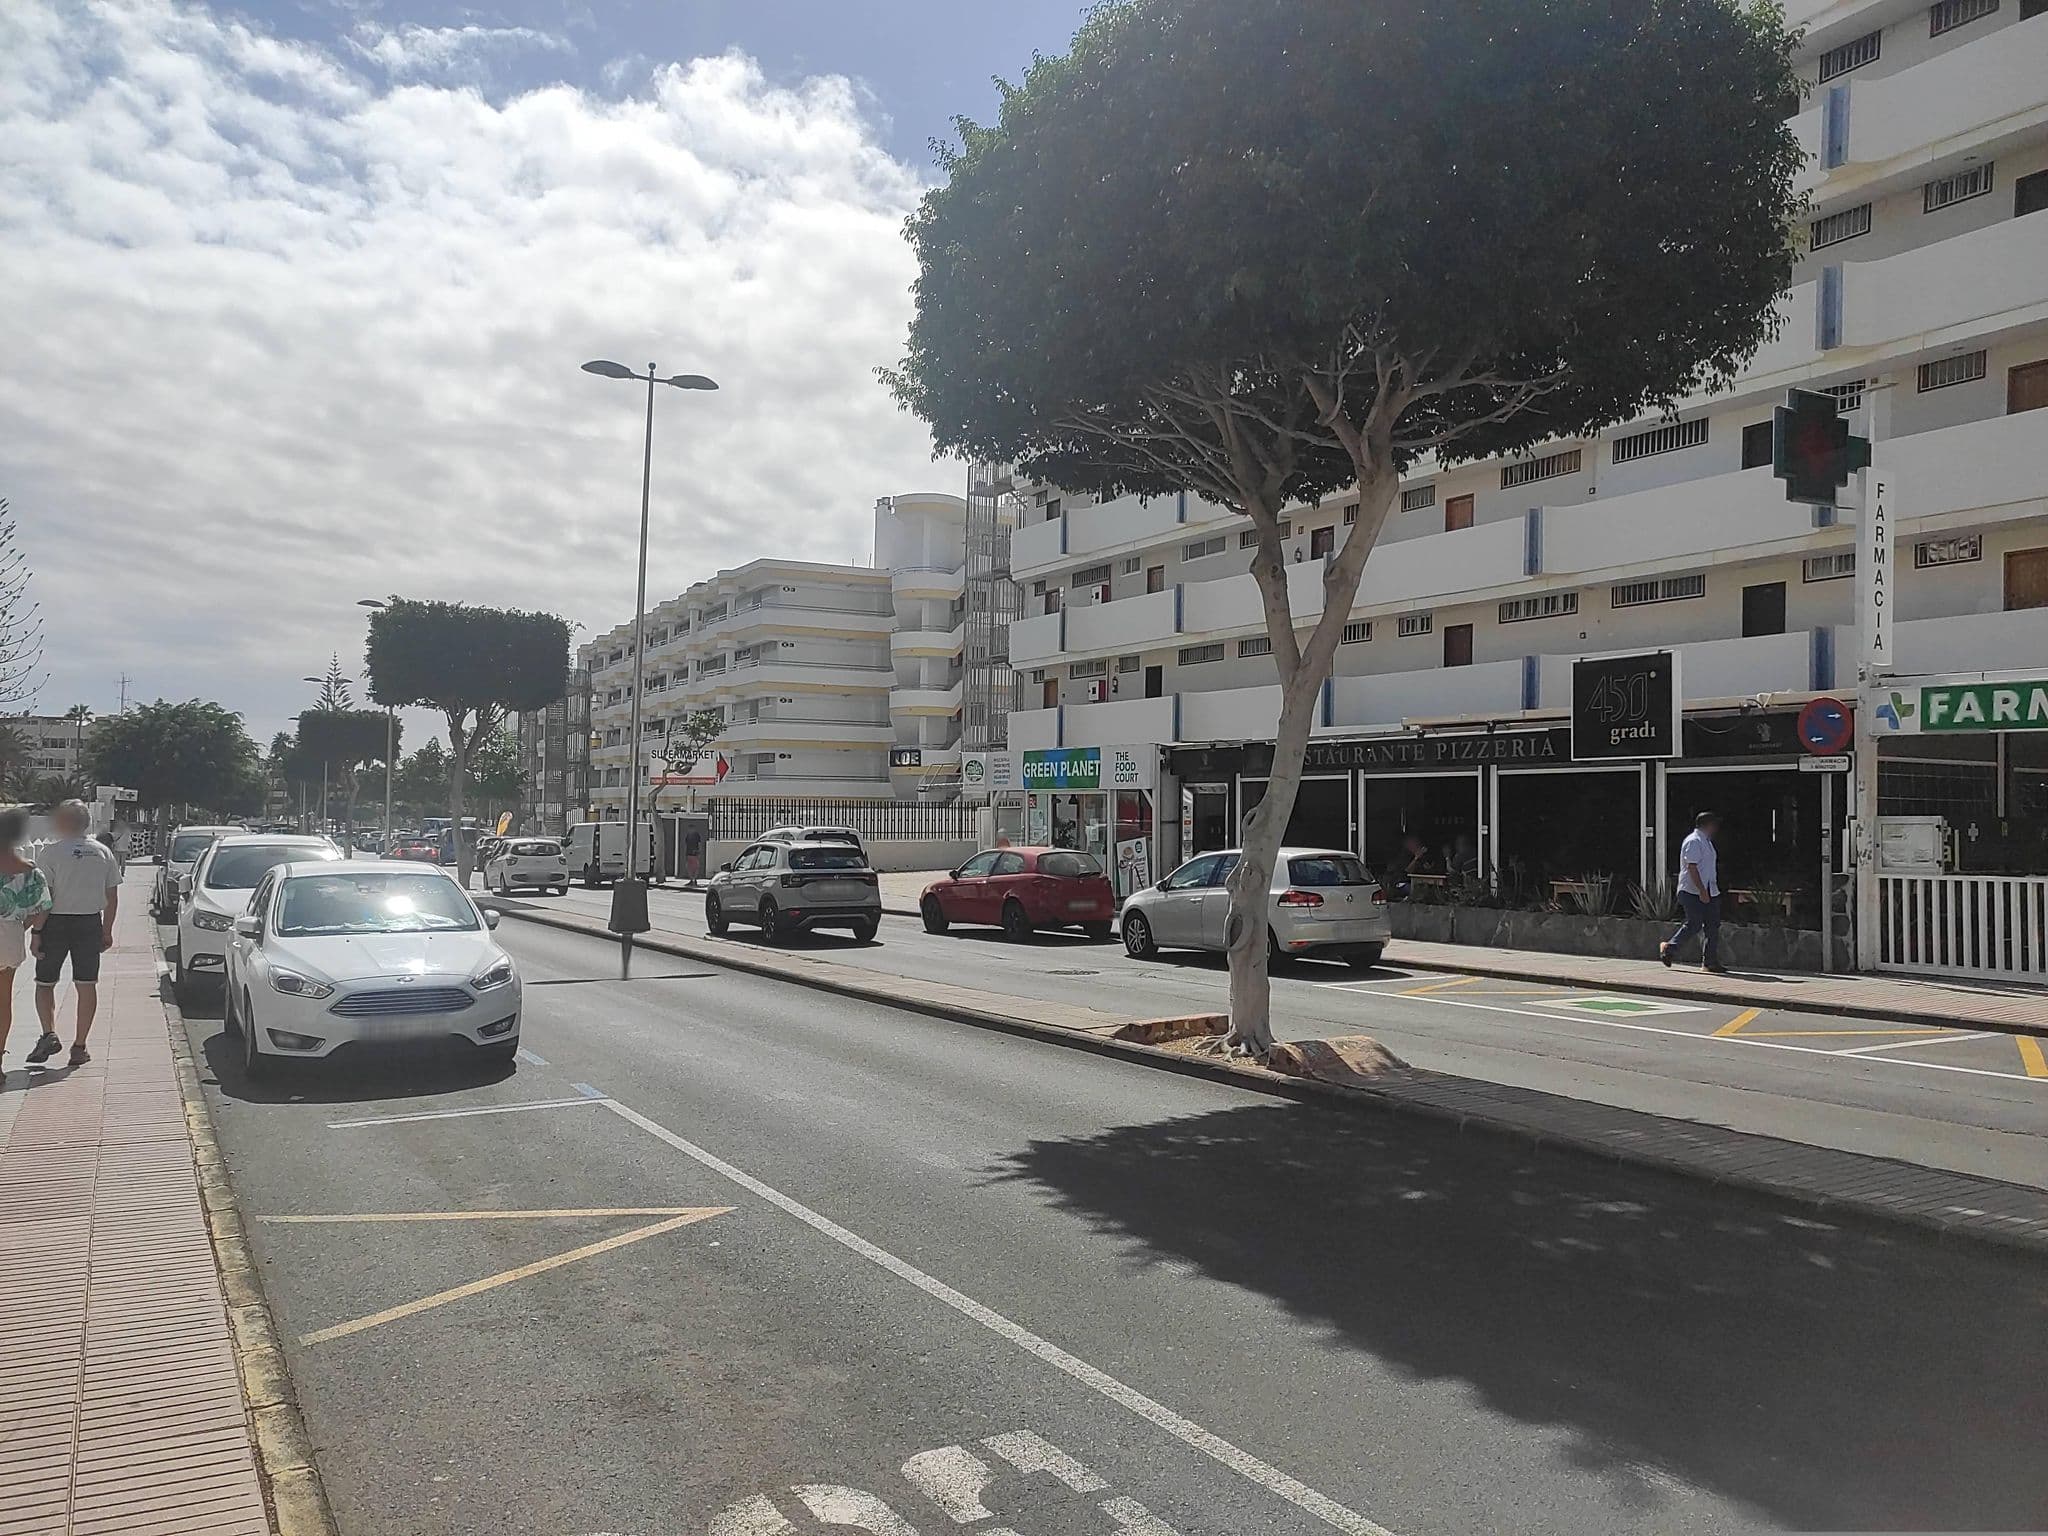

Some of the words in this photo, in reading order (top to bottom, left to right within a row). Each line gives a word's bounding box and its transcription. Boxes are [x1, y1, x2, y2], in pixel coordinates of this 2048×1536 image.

[1873, 482, 1886, 651] FARMACIA
[651, 749, 715, 759] SUPERMARKET
[1115, 751, 1129, 761] THE
[1304, 743, 1425, 766] STAURANTE
[1436, 736, 1557, 760] PIZZERIA
[1023, 761, 1058, 778] GREEN
[1060, 759, 1101, 777] PLANET
[1115, 762, 1136, 772] FOOD
[1114, 772, 1139, 783] COURT
